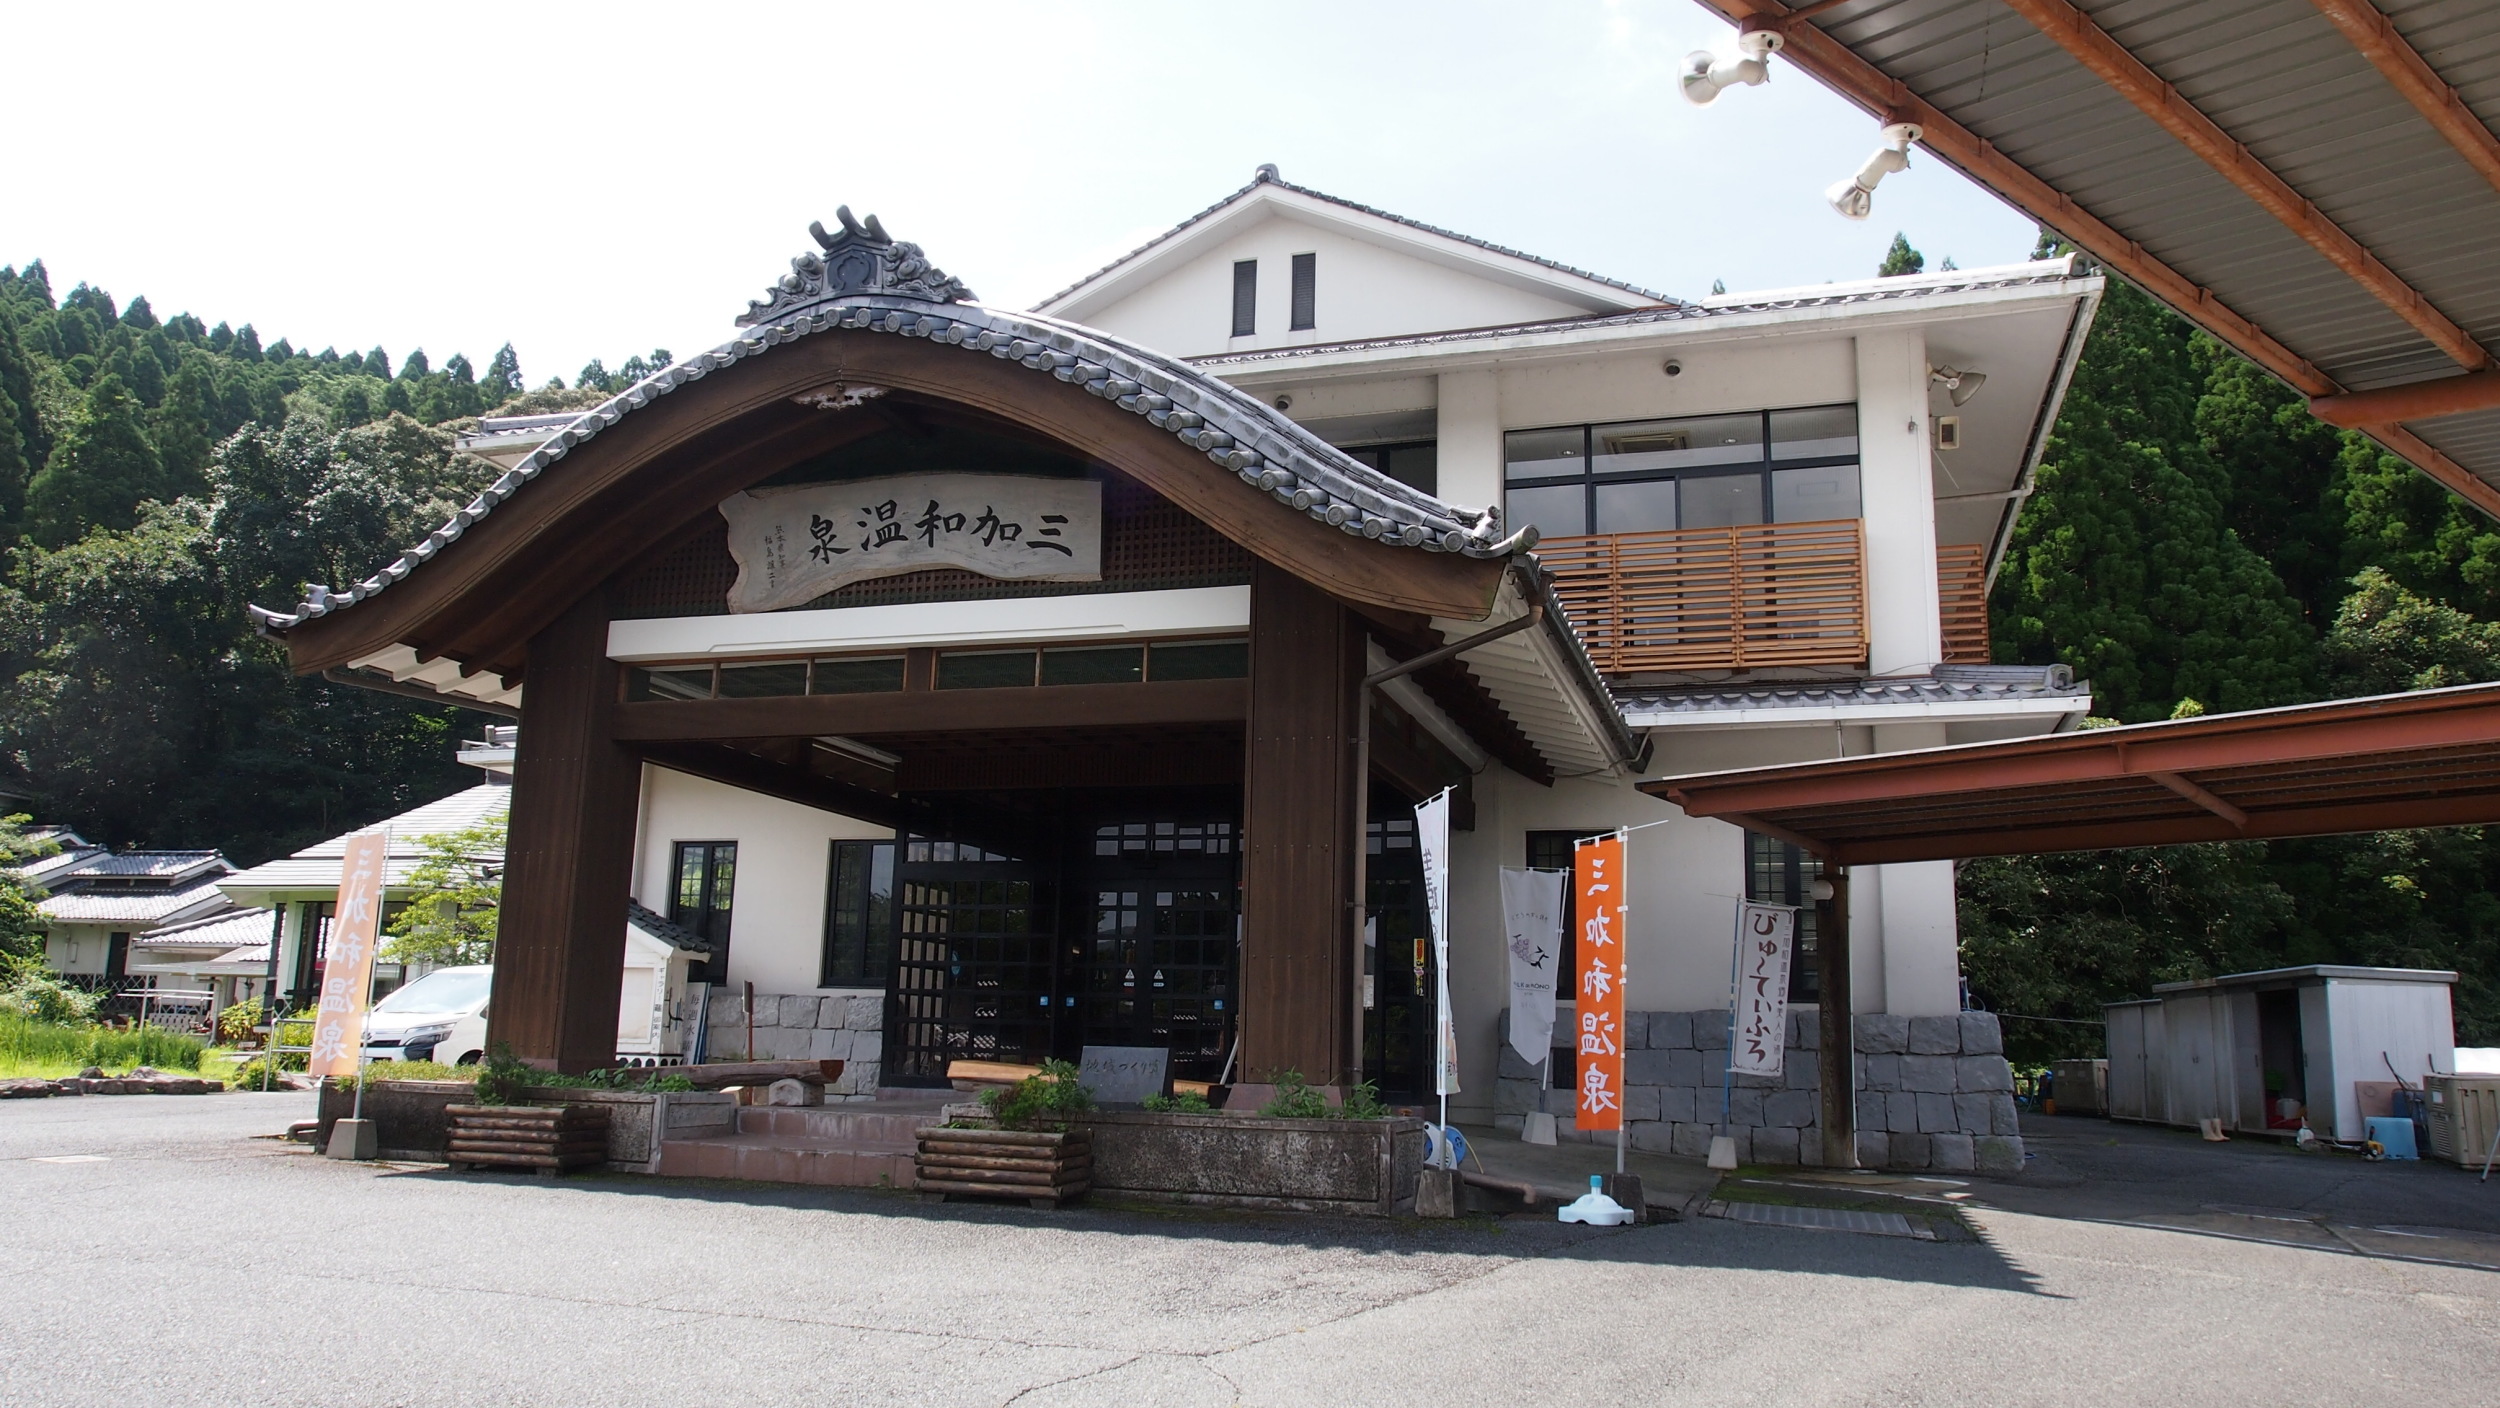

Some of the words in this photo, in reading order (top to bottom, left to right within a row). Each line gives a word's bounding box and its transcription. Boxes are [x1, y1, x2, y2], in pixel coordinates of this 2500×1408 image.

[807, 499, 1073, 565] 三加和温泉
